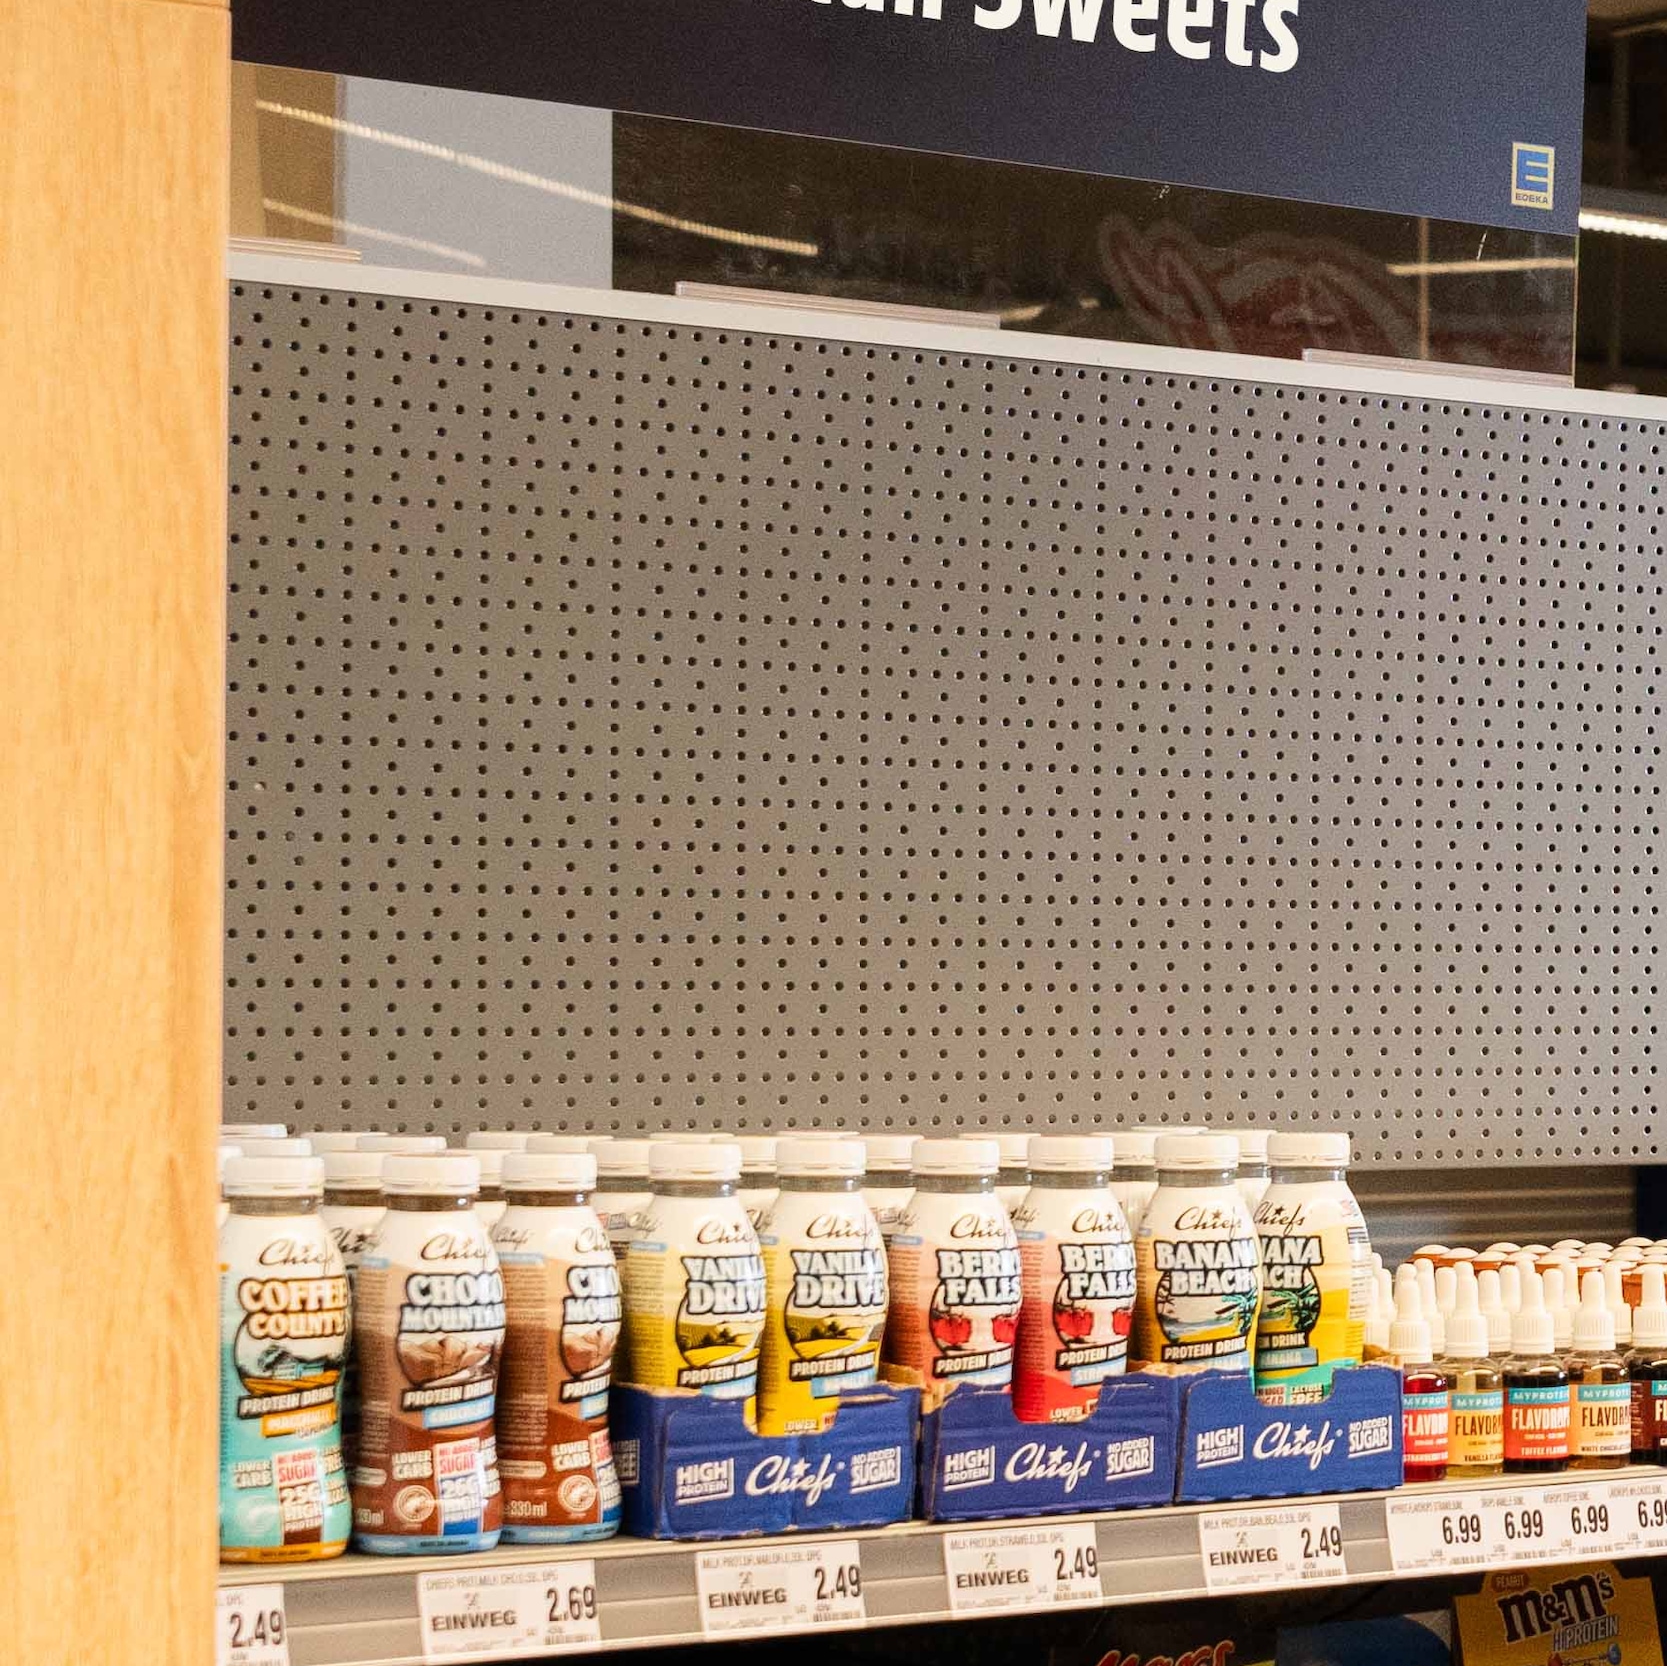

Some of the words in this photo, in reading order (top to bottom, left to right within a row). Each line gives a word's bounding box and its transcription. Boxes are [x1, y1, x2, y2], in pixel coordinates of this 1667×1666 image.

[1197, 1429, 1241, 1452] HIGH
[1252, 1421, 1337, 1471] Chiefs
[943, 1451, 993, 1472] HIGH
[1004, 1442, 1093, 1492] Chiefs
[675, 1466, 729, 1487] HIGH
[745, 1455, 836, 1505] Chiefs
[1054, 1546, 1098, 1580] 2.49
[1209, 1547, 1278, 1565] EINWEG
[814, 1565, 862, 1600] 2.49
[956, 1569, 1029, 1588] EINWEG
[546, 1586, 596, 1622] 2.69
[708, 1587, 787, 1609] EINWEG
[229, 1610, 283, 1647] 2.49
[432, 1611, 517, 1632] EINWEG
